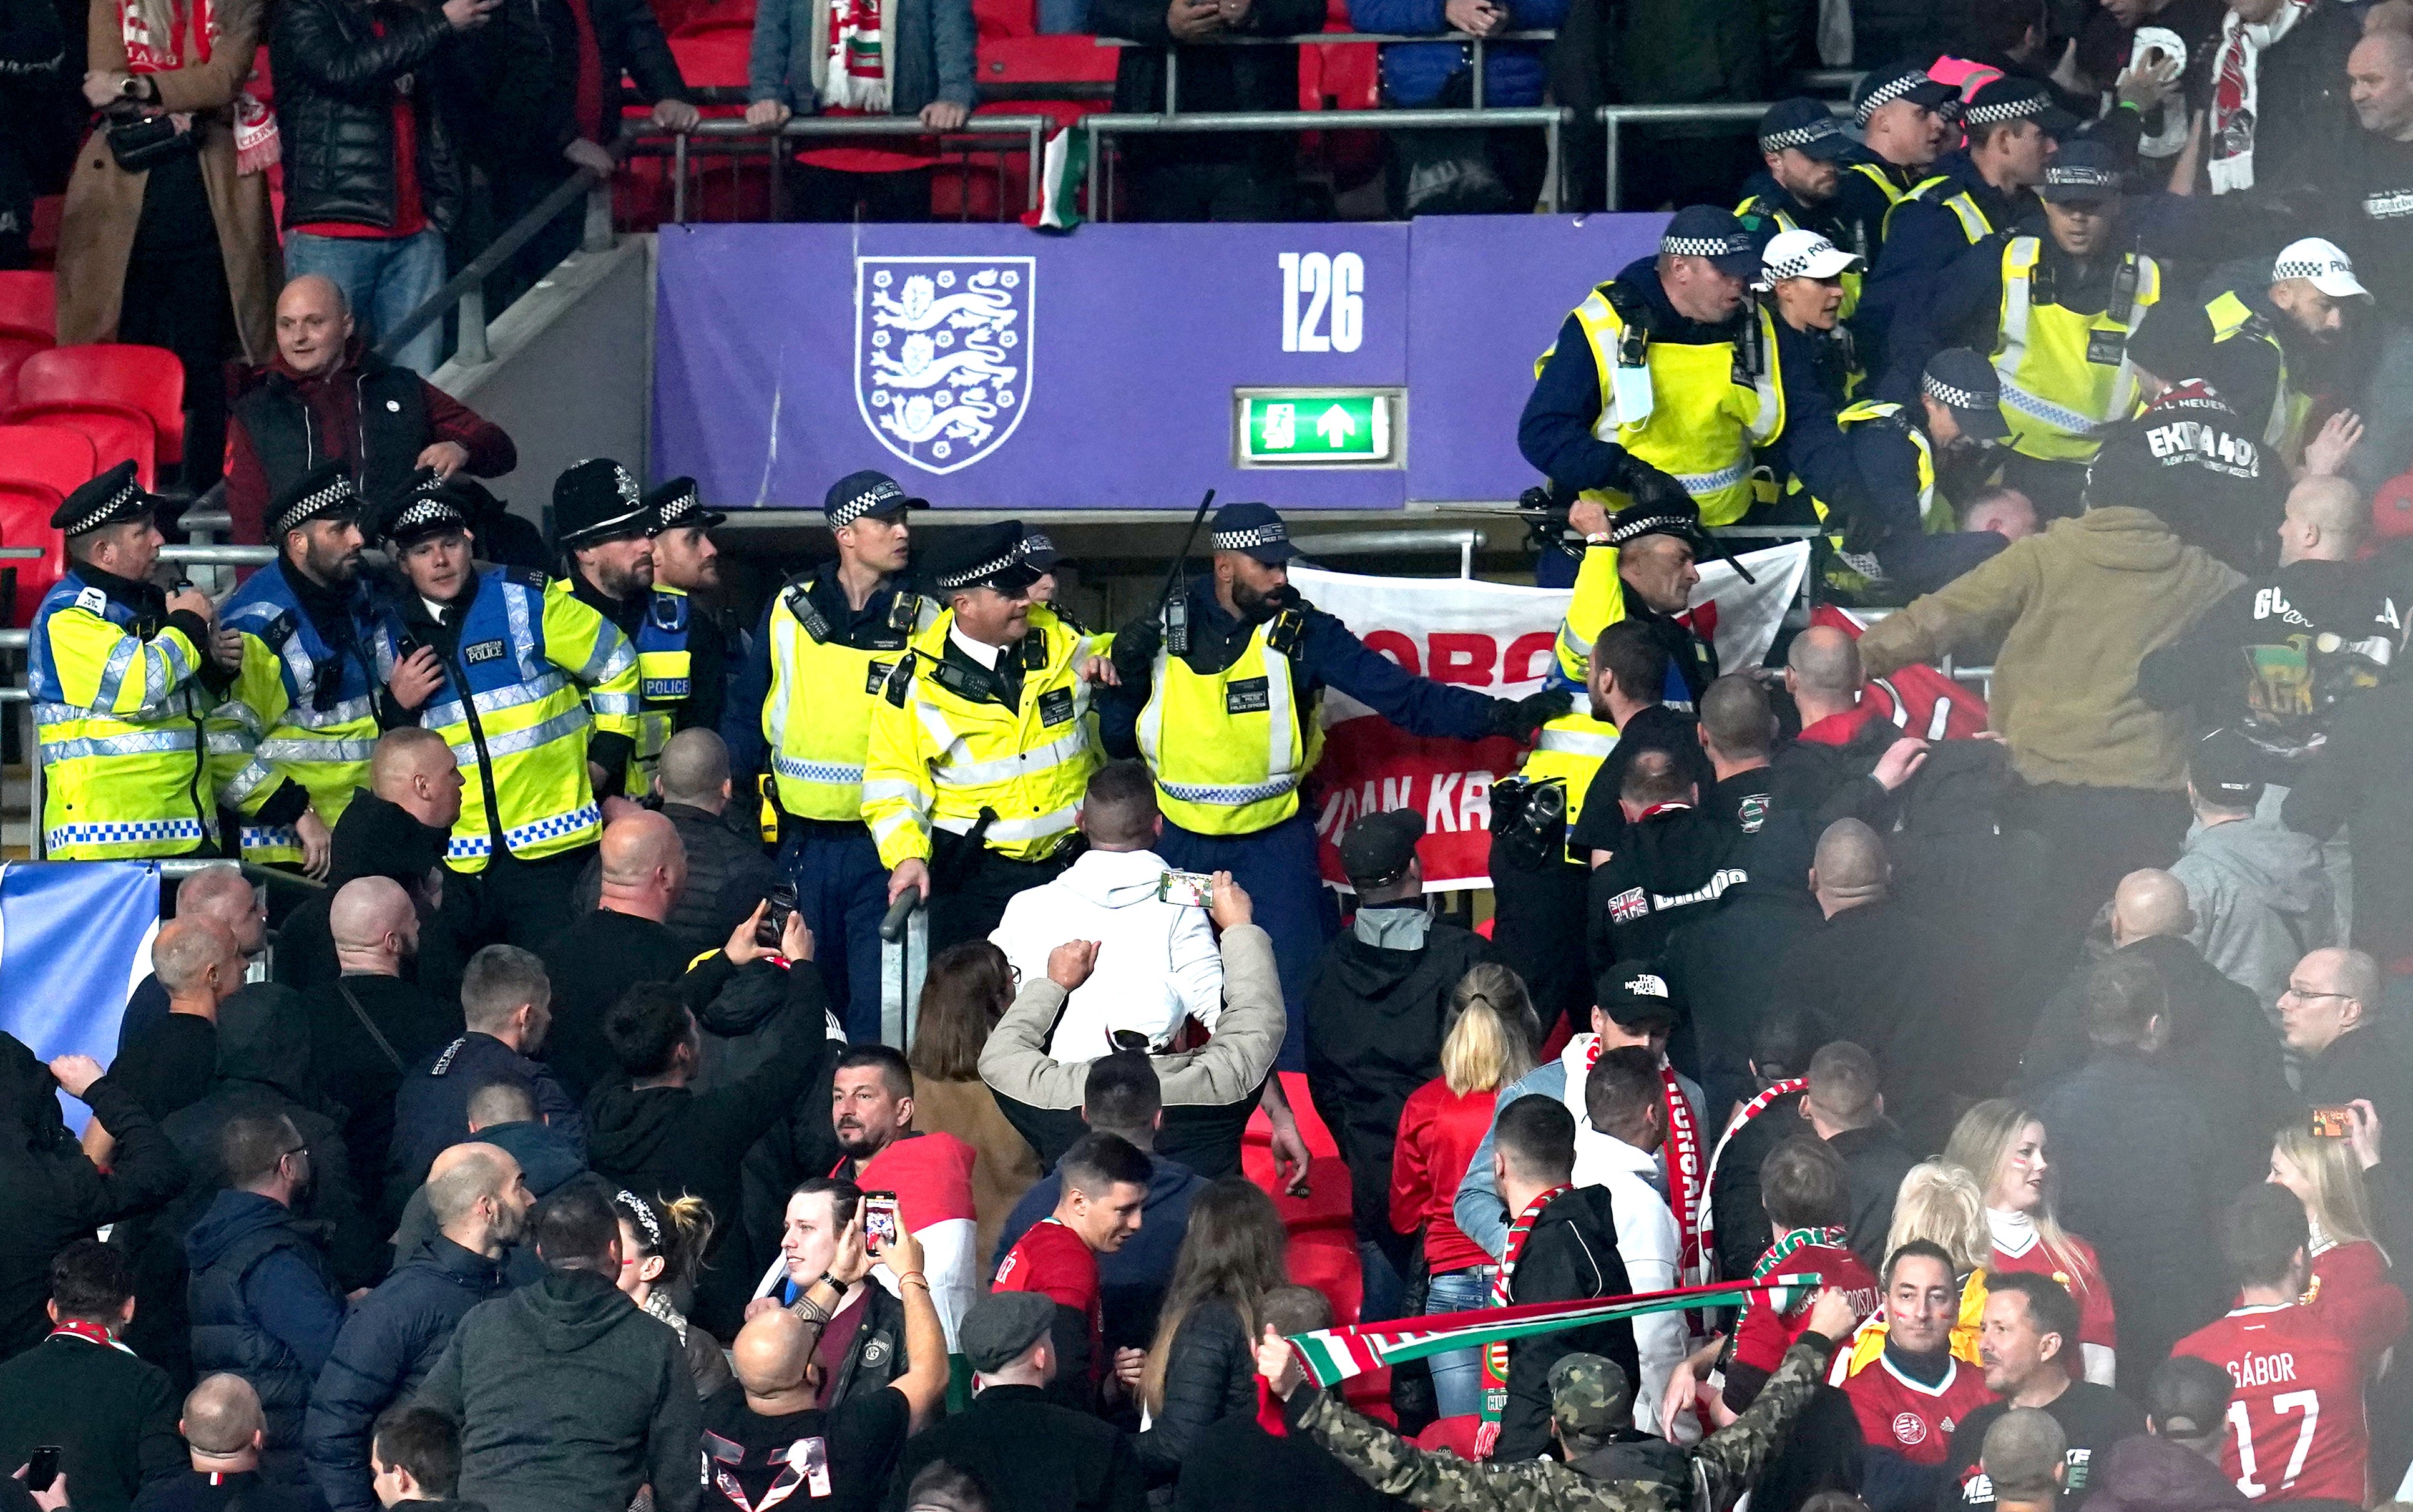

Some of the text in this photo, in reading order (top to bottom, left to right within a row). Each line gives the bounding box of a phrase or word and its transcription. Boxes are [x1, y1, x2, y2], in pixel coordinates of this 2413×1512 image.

[1278, 251, 1364, 353] 126
[469, 646, 503, 663] POLICE
[647, 680, 688, 695] POLICE
[1625, 981, 1655, 990] NORTH
[2226, 1351, 2297, 1388] GÁBOR
[2227, 1389, 2320, 1500] 17
